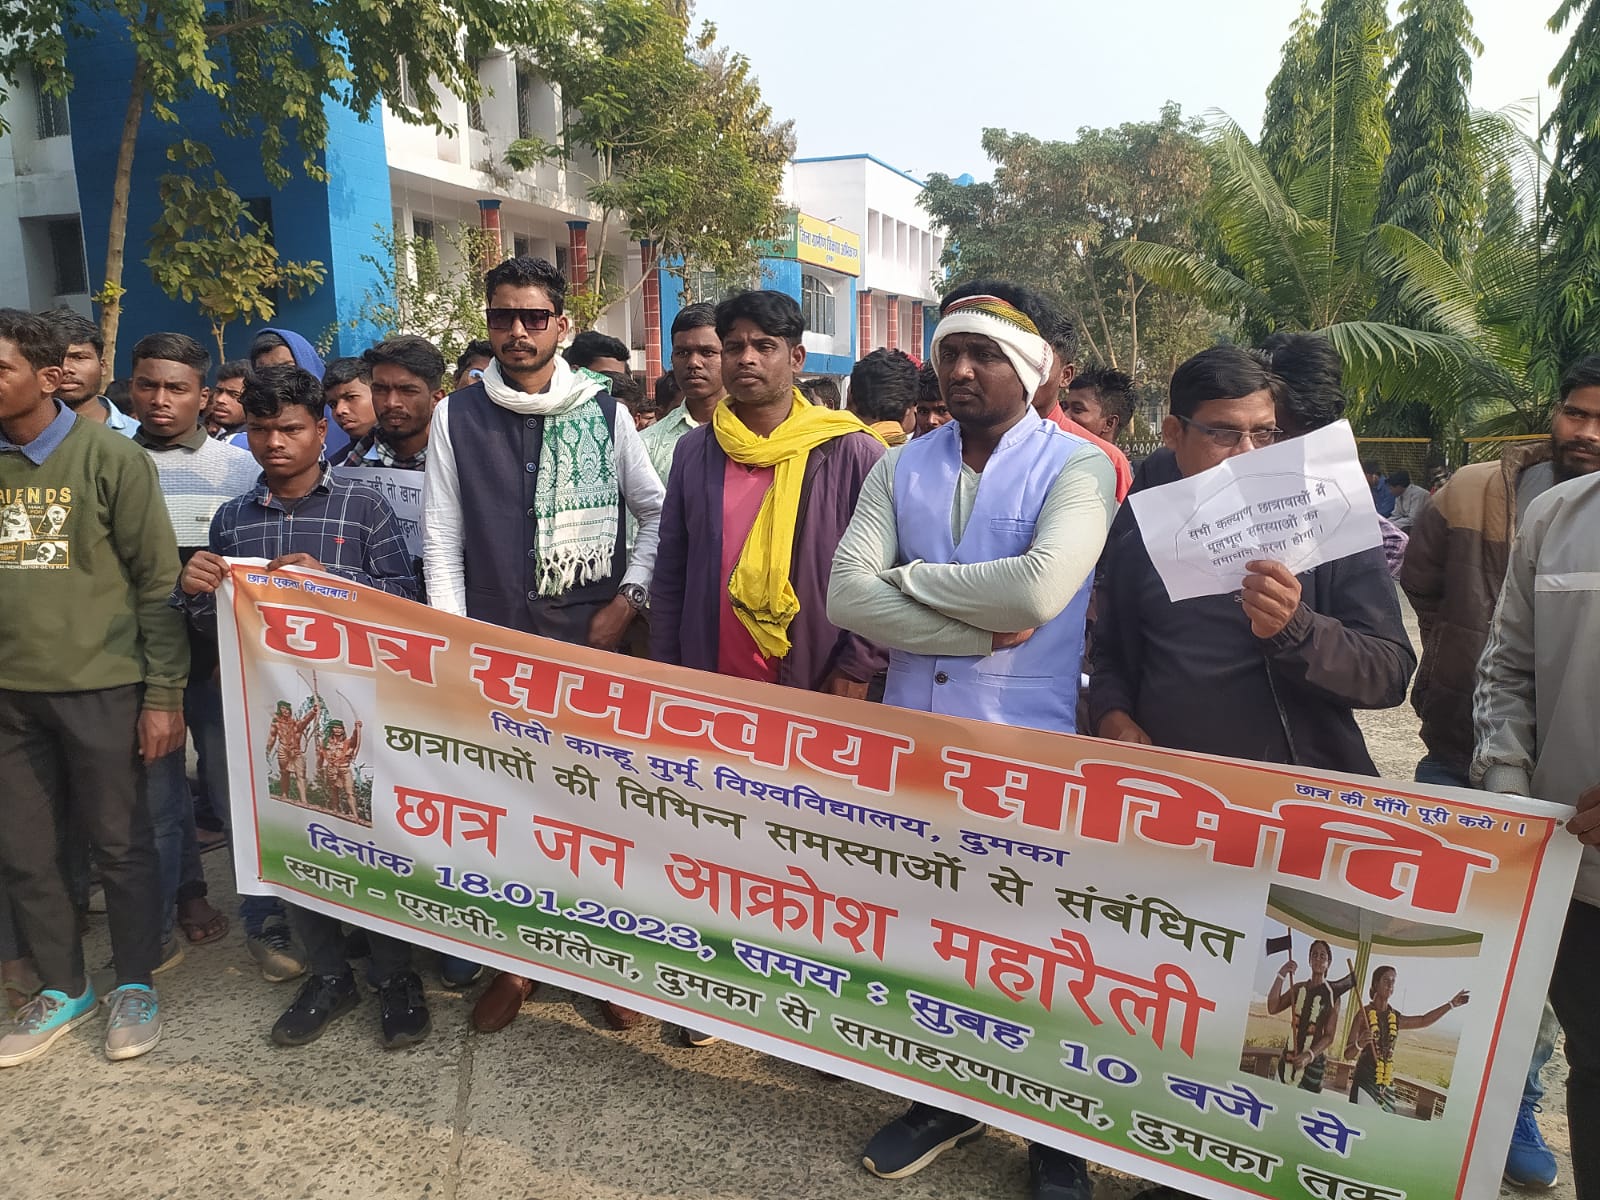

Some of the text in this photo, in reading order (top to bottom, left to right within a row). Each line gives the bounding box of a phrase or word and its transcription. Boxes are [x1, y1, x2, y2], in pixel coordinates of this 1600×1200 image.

[386, 477, 396, 500] तो
[399, 486, 421, 505] खाना
[1188, 483, 1326, 541] सभी कल्याण छात्रावासों में
[1247, 514, 1298, 537] समस्याओं
[247, 574, 268, 584] छात्र
[304, 581, 349, 599] जिन्दाबाद
[257, 604, 1493, 914] छात्र समन्वय समिति
[490, 712, 1071, 867] सिदो कान्हू मुर्मू विश्वविद्यालय, दुमका
[1296, 783, 1331, 800] छात्र
[1341, 791, 1365, 807] की
[1374, 797, 1410, 815] माँगे
[1418, 807, 1449, 825] पूरी
[1458, 815, 1495, 830] करो
[384, 724, 1246, 963] छात्रावासों की विभिन्न समस्याओं से संबंधित
[307, 823, 413, 875] दिनांक
[437, 867, 715, 959] 18.01.2023,
[734, 939, 848, 994] समय
[909, 992, 1031, 1049] सुबह
[1062, 1043, 1138, 1085] 10
[1167, 1075, 1273, 1127] बजे
[1301, 1110, 1361, 1154] से
[394, 785, 1217, 1060] छात्र जन आक्रोश महारैली
[287, 857, 356, 896] स्थान
[397, 892, 507, 939] एस.पी.
[520, 926, 642, 981] कॉलेज,
[657, 965, 763, 1014] दुमका
[780, 996, 816, 1030] से
[834, 1017, 1113, 1128] समाहरणालय,
[1133, 1112, 1279, 1181] दुमका
